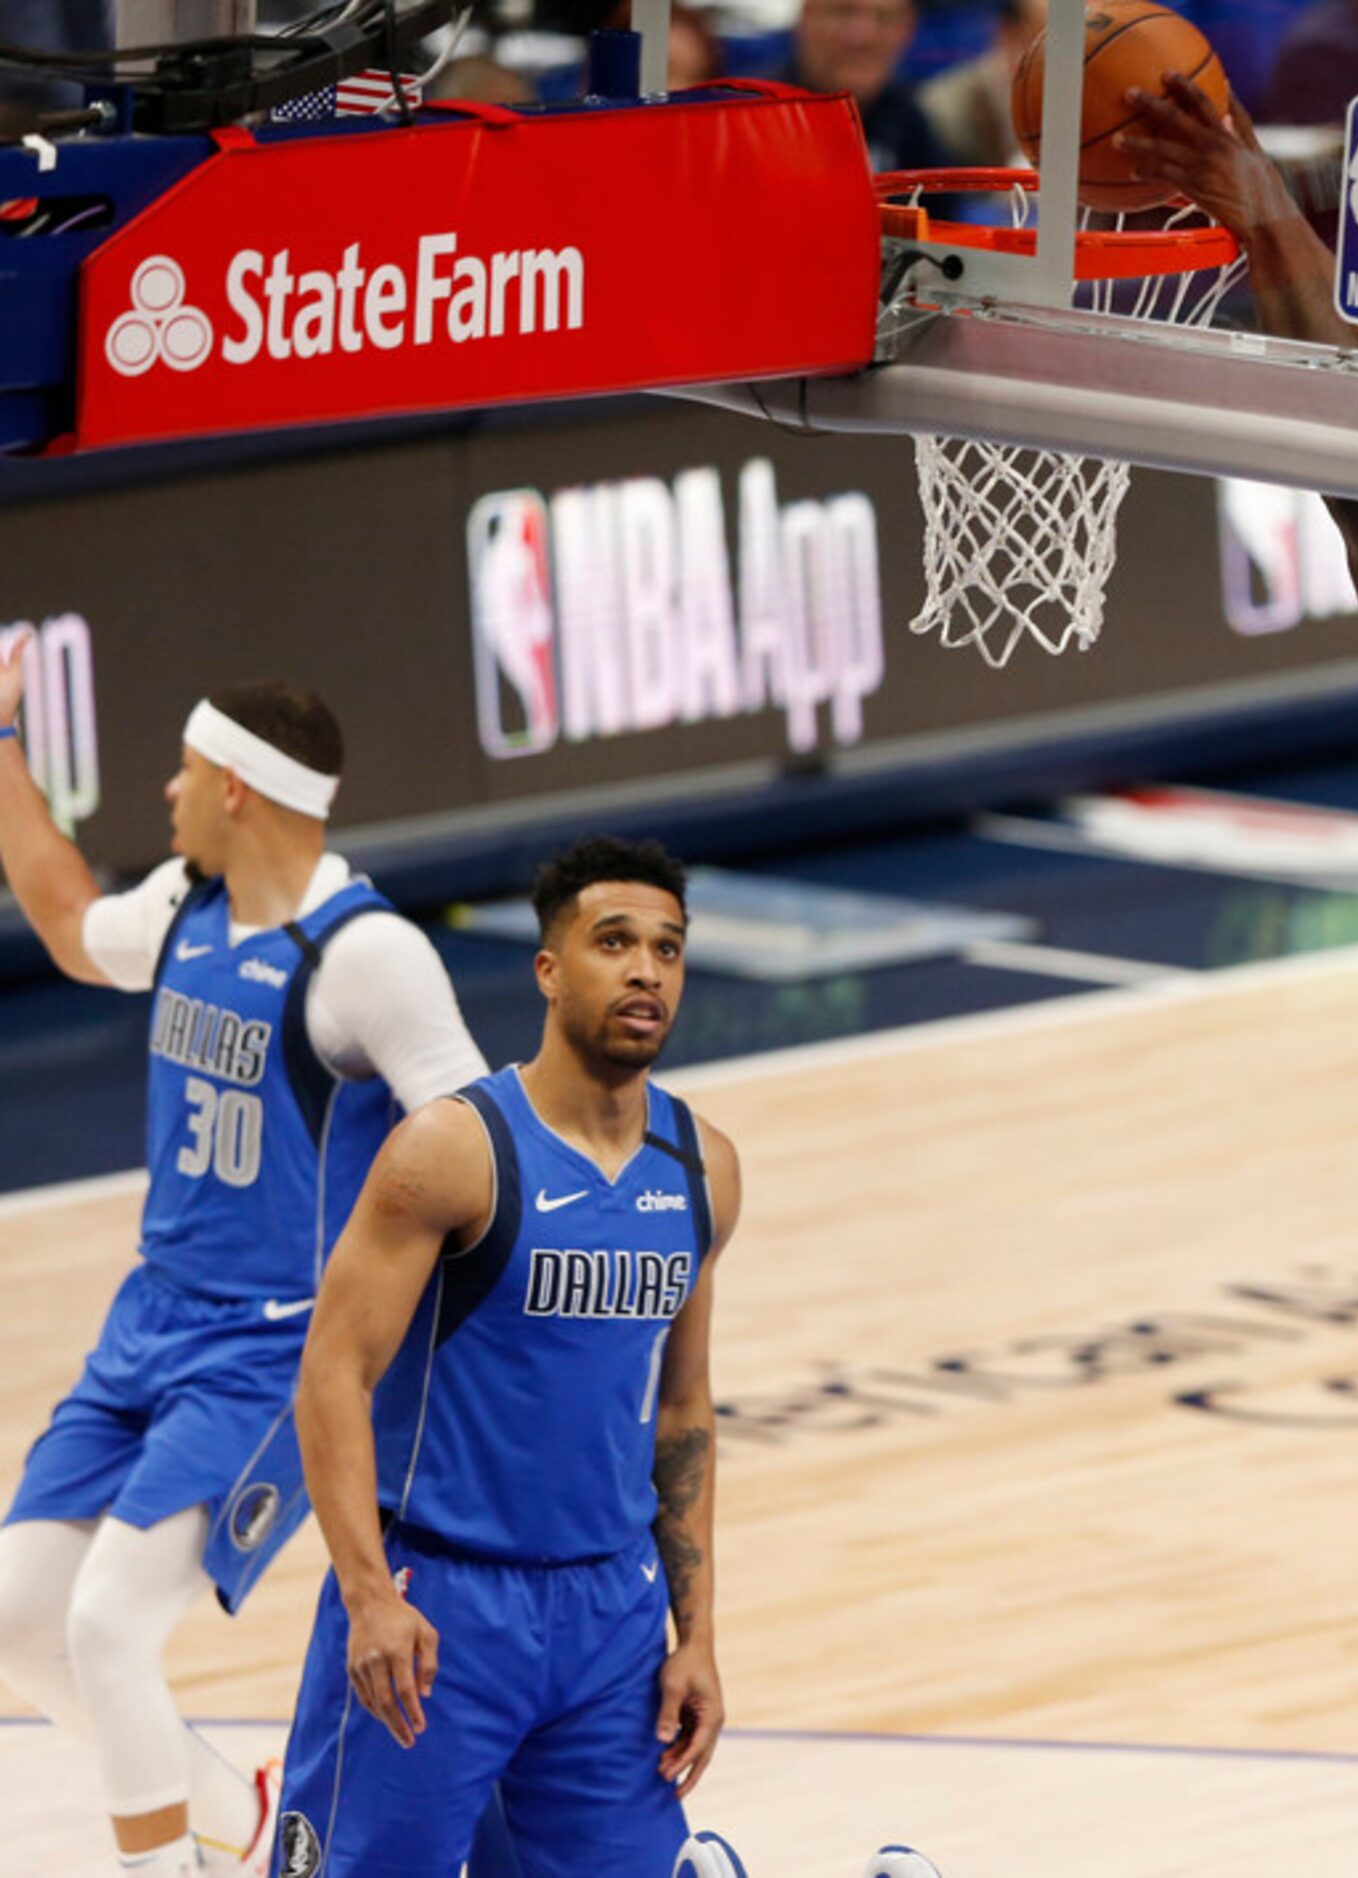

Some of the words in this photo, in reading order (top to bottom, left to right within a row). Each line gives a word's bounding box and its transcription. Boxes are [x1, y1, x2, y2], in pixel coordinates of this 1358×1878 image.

[150, 985, 272, 1087] DALLAS
[176, 1076, 263, 1188] 30
[523, 1248, 691, 1319] DALLAS
